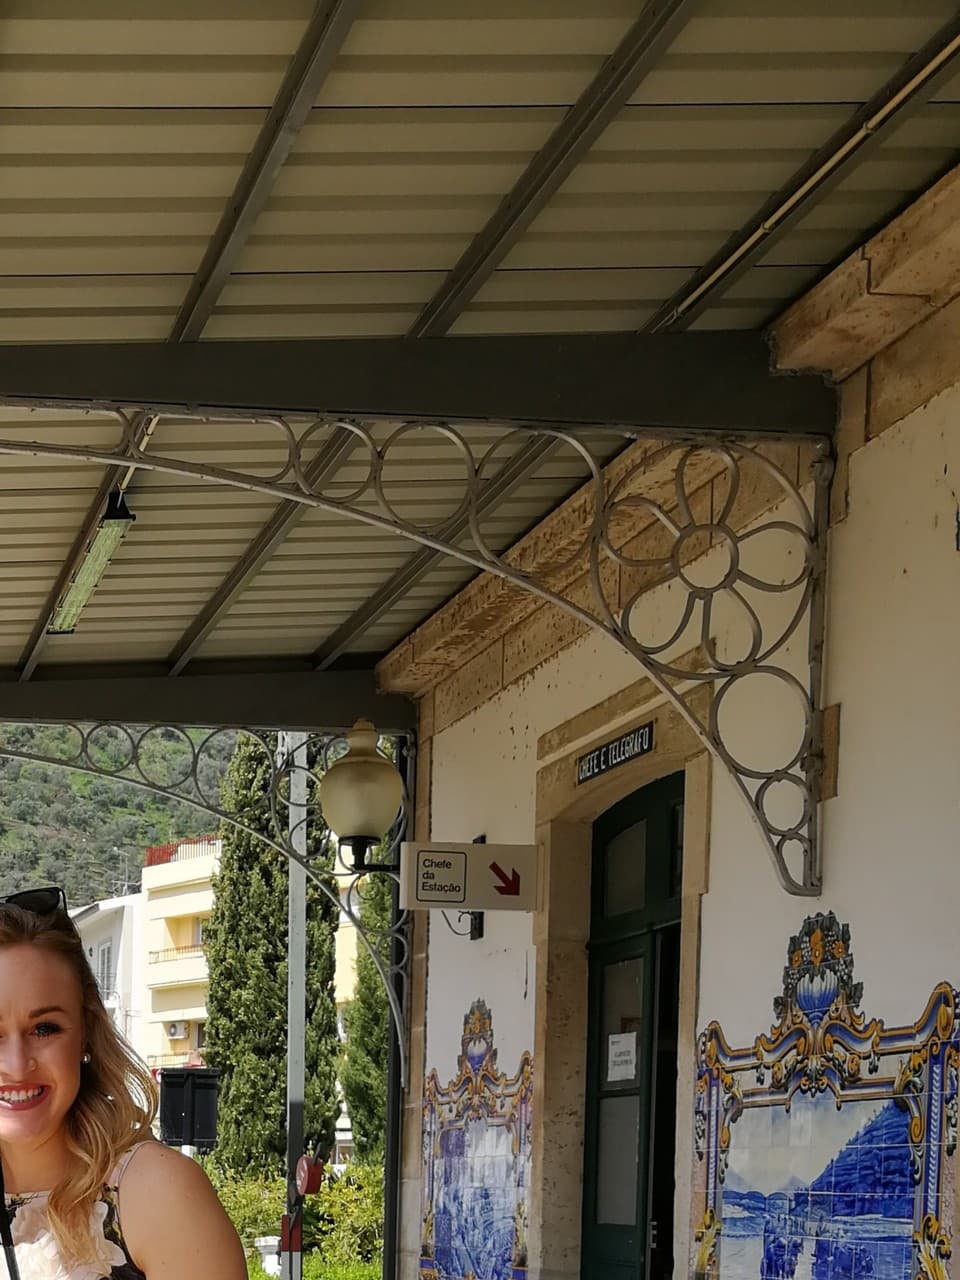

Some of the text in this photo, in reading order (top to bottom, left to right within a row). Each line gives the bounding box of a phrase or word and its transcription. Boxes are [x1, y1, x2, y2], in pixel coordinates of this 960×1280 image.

[601, 747, 607, 770] E
[422, 858, 452, 869] Chefe
[422, 870, 435, 880] da
[421, 881, 461, 894] Estação
